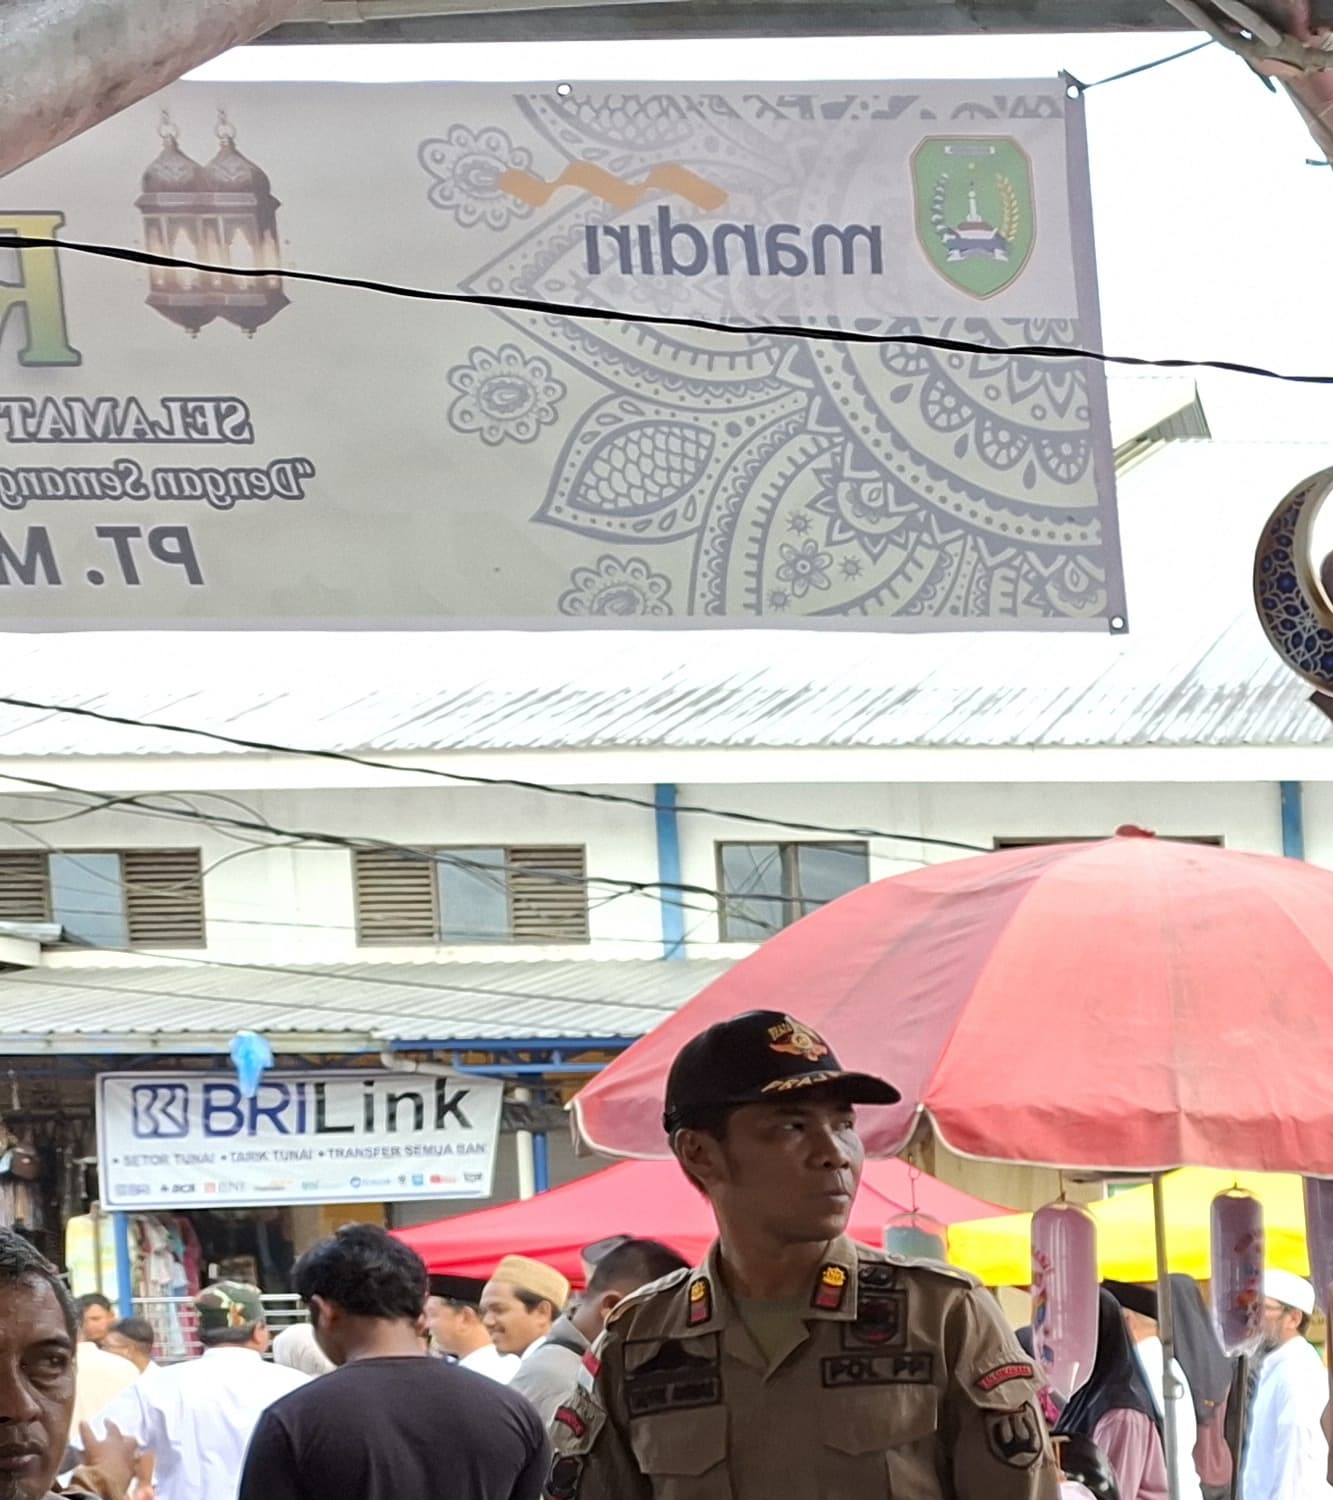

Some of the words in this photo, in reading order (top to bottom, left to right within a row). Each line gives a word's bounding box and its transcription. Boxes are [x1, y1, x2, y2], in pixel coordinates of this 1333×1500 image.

[203, 1078, 472, 1137] BRILink
[329, 1145, 401, 1158] TRANSFER
[404, 1143, 453, 1156] SEMUA
